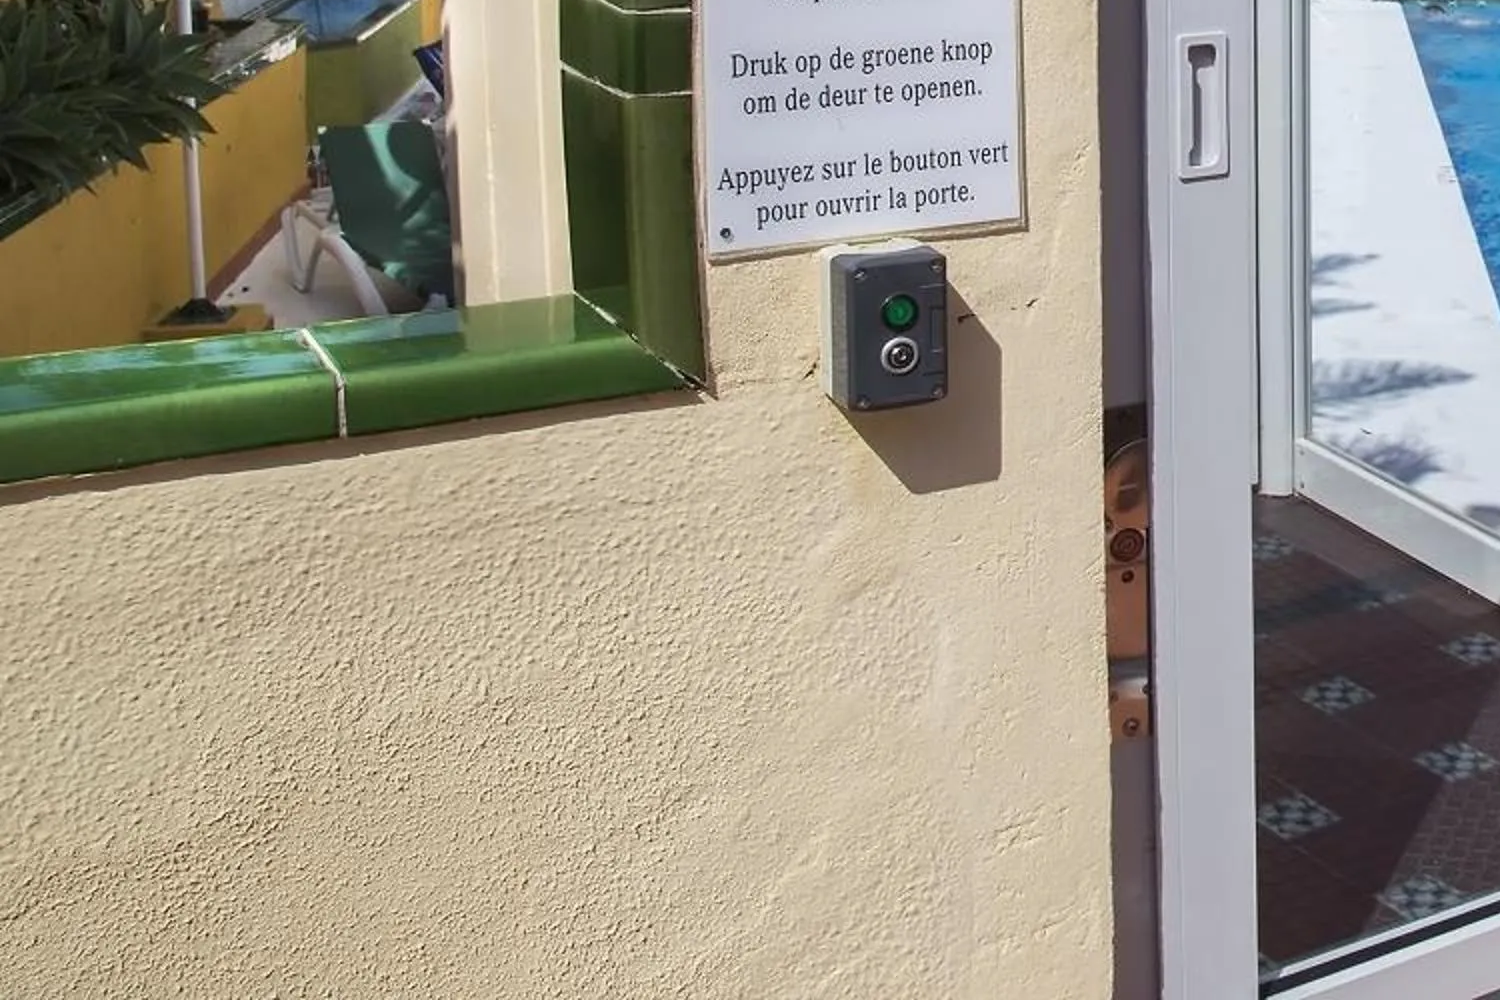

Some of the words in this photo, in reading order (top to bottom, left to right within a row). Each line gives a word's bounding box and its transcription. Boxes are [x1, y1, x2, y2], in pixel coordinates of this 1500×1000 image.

[731, 51, 788, 78] Druk
[795, 54, 821, 78] op
[830, 46, 854, 70] de
[862, 46, 934, 74] groene
[941, 39, 992, 65] knop
[744, 96, 776, 115] om
[785, 87, 810, 111] de
[818, 84, 868, 108] deur
[874, 84, 894, 104] te
[902, 80, 982, 107] openen.
[717, 165, 814, 196] Appuyez
[822, 160, 856, 180] sur
[864, 153, 882, 176] le
[890, 149, 962, 173] bouton
[968, 142, 1008, 164] vert
[757, 202, 808, 230] pour
[816, 190, 882, 216] ouvrir
[889, 187, 907, 209] la
[915, 184, 974, 211] porte.
